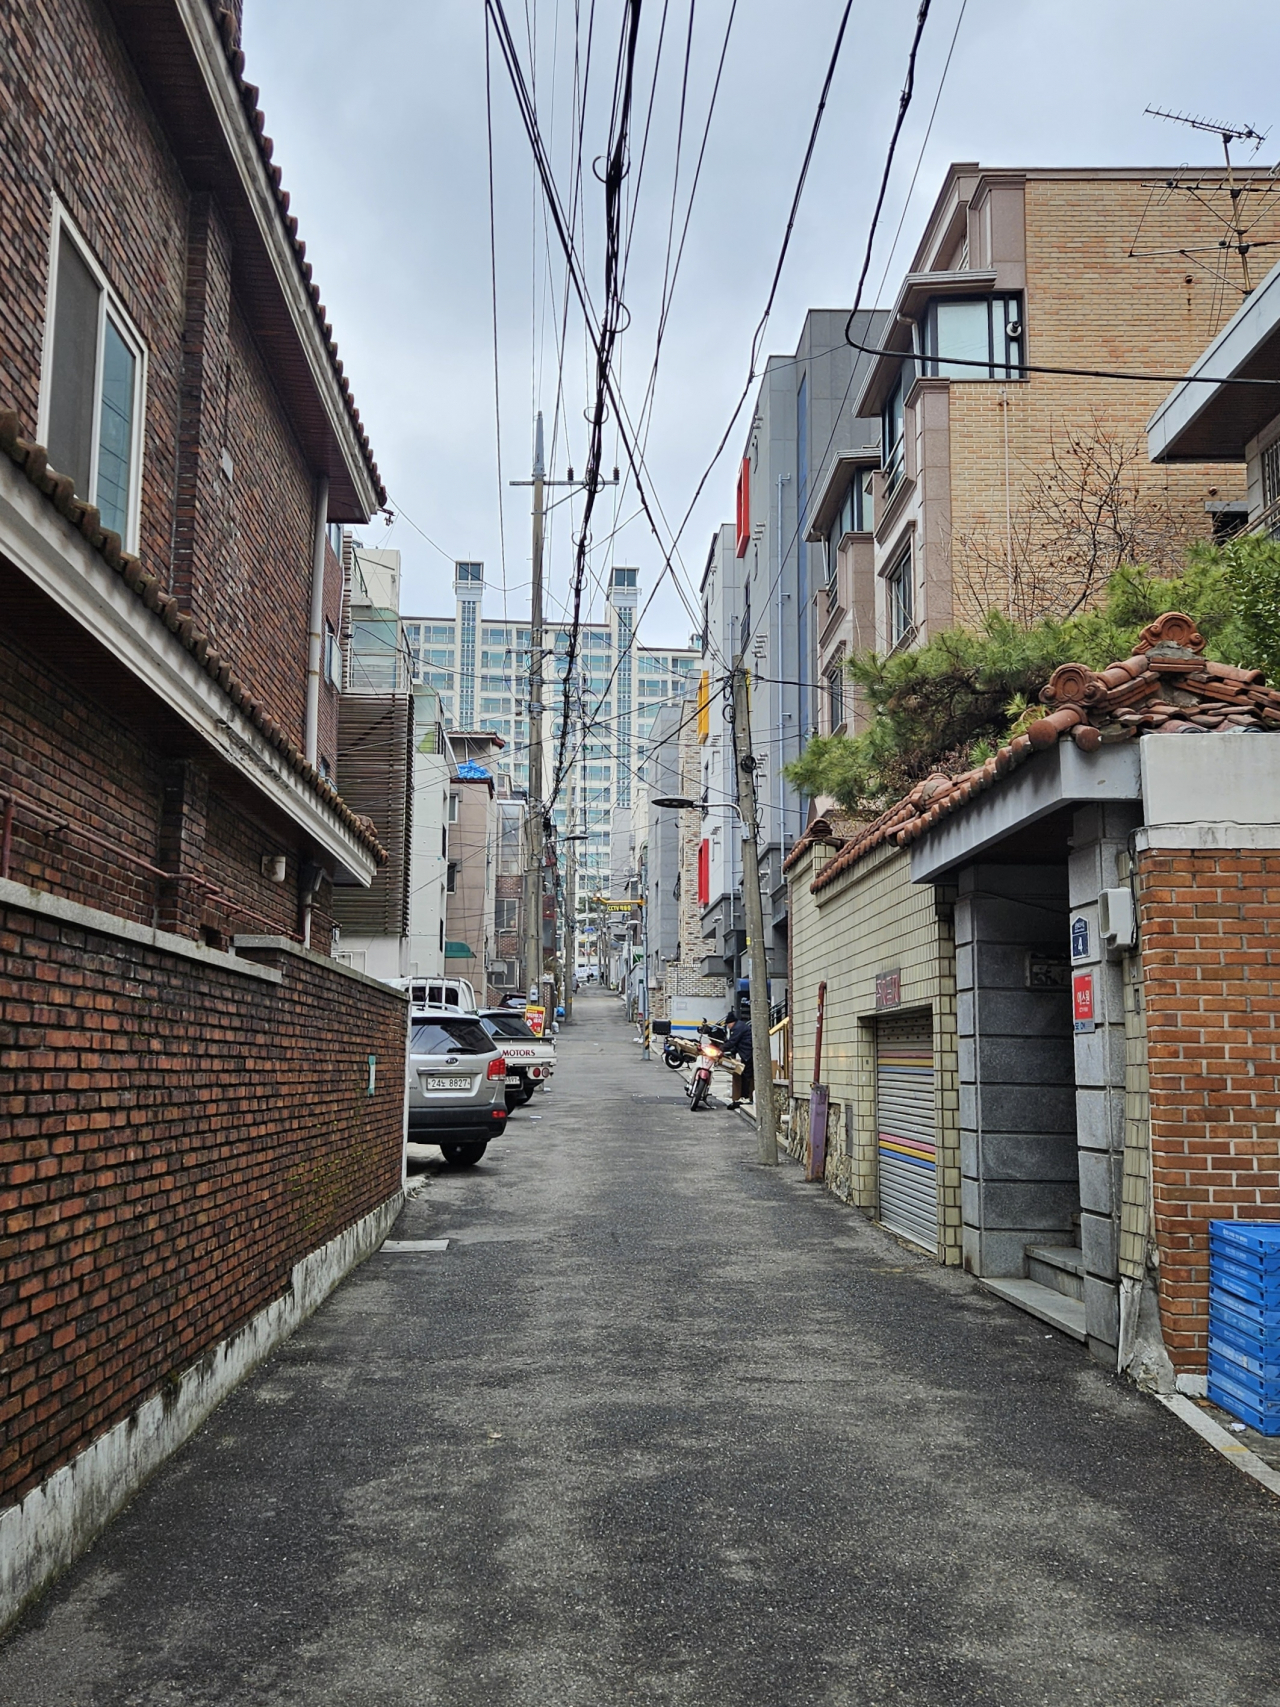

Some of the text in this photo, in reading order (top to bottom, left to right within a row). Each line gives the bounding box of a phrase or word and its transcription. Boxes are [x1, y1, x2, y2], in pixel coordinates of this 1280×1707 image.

[1078, 936, 1083, 954] 4
[502, 1049, 536, 1057] MOTORS
[448, 1078, 468, 1087] 8827
